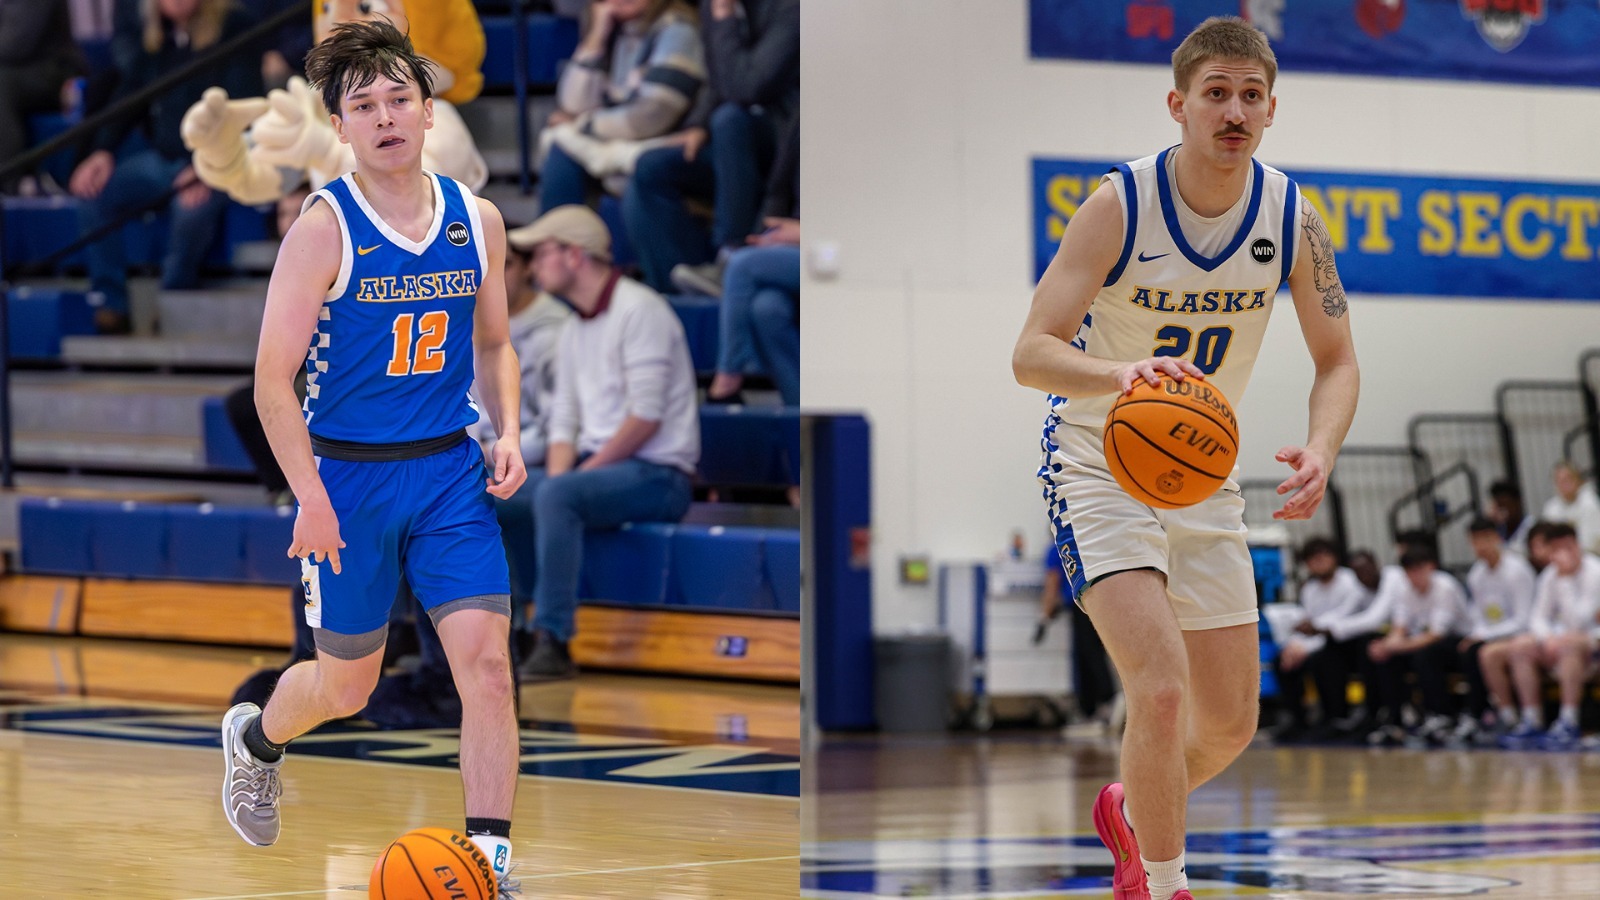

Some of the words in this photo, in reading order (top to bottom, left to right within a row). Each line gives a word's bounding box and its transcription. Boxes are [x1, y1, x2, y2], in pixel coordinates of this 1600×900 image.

[448, 228, 468, 240] WIN
[1252, 246, 1274, 256] WIN
[357, 270, 478, 303] ALASKA
[1129, 285, 1270, 315] ALASKA
[386, 310, 449, 376] 12
[1152, 323, 1235, 377] 20
[1164, 380, 1238, 432] Wilson
[1168, 421, 1220, 458] EVO
[433, 865, 468, 900] EV
